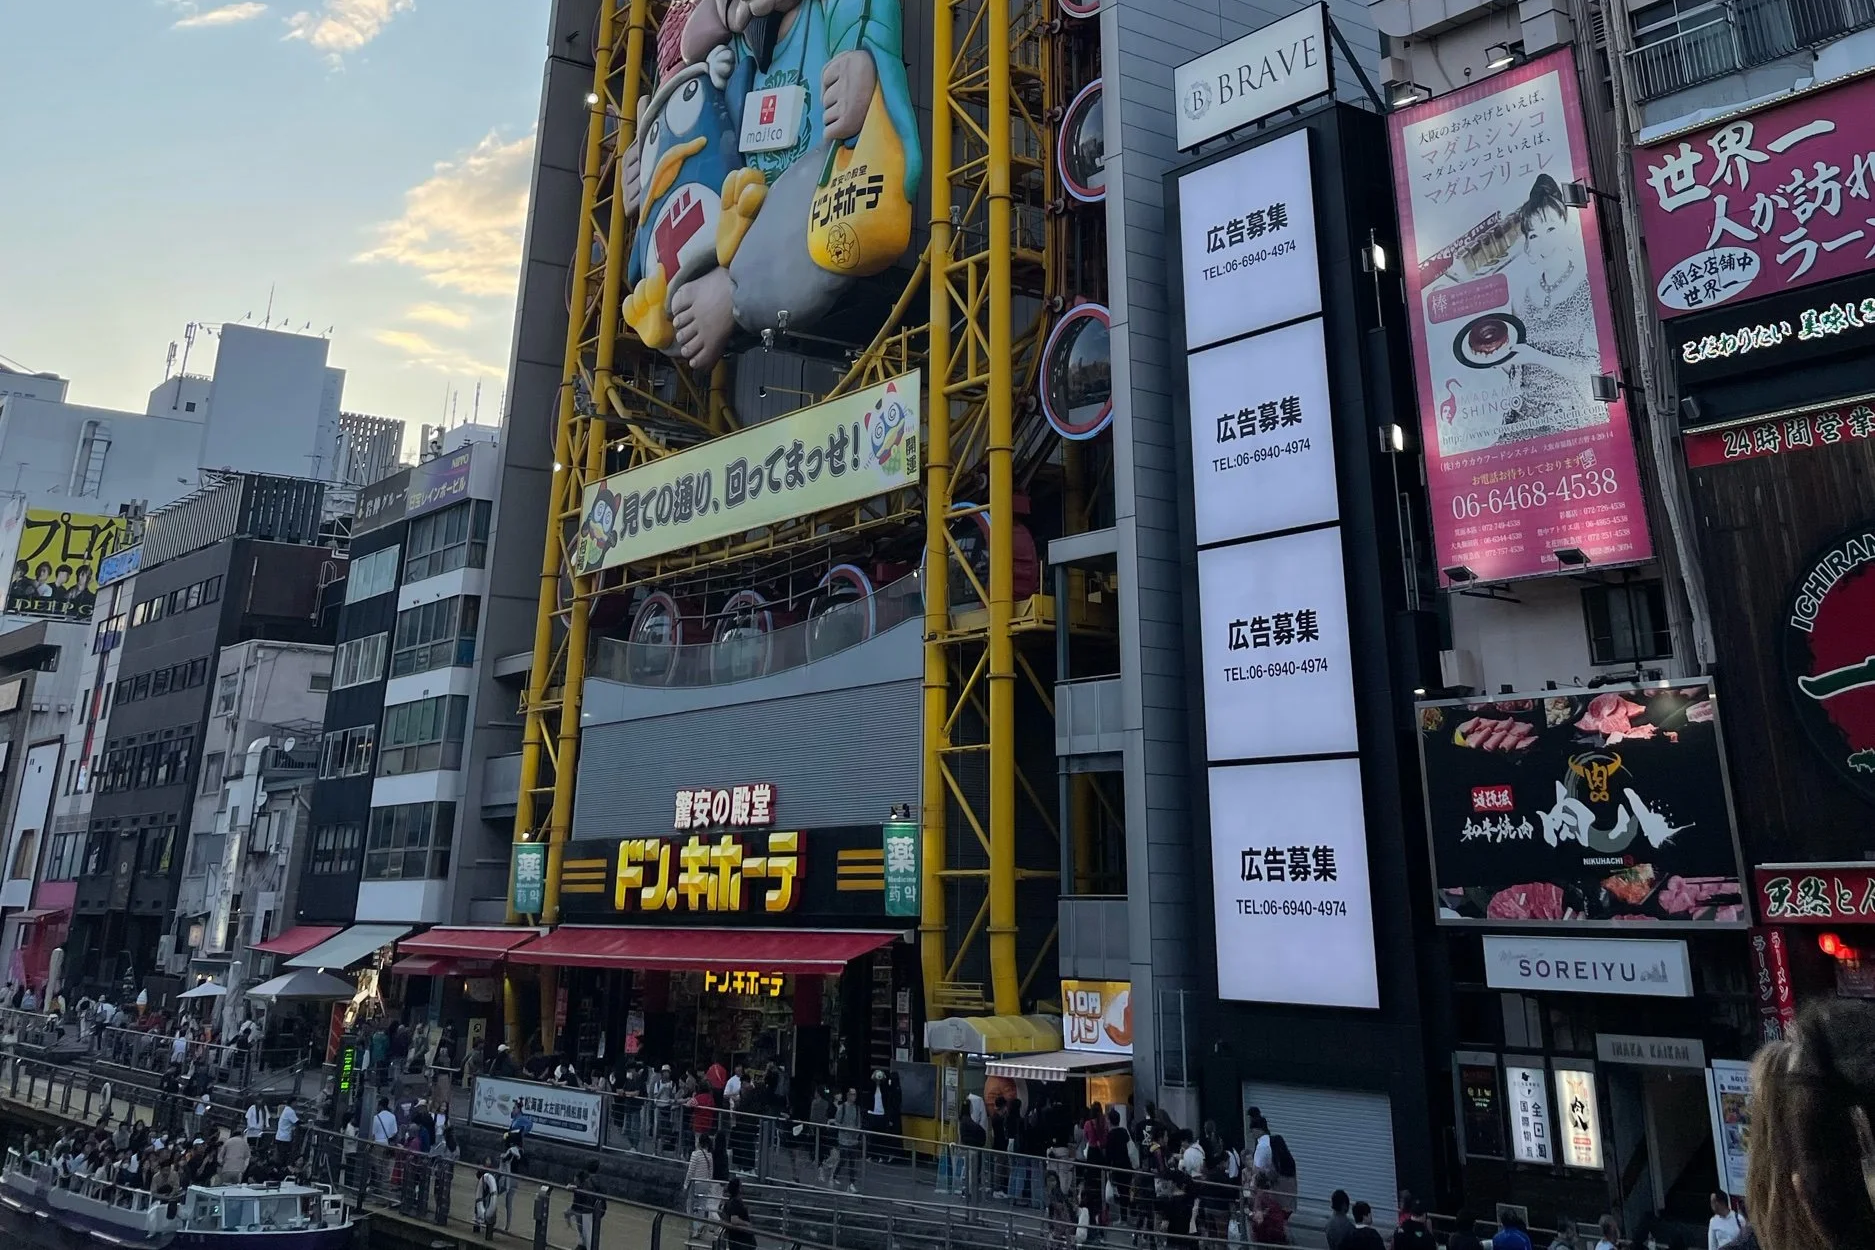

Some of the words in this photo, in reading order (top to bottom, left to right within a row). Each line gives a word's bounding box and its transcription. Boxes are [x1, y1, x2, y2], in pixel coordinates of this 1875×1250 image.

[1217, 34, 1318, 106] BRAVE
[1421, 110, 1545, 166] マダムシンコ
[1424, 152, 1555, 205] マダムブリュレ
[1646, 119, 1836, 213] 世界一
[1206, 203, 1289, 255] 広告募集
[1202, 239, 1297, 281] TEL:06-6940-4974
[1660, 253, 1754, 298] 一蘭全店舗中
[1683, 279, 1740, 308] 世界一
[1682, 321, 1792, 363] こだわりたい
[1216, 396, 1302, 444] 広告募集
[1722, 405, 1875, 458] 24時間営業
[1212, 438, 1312, 474] TEL:06-6940-4974
[1452, 467, 1618, 521] 06-6468-4538
[1228, 609, 1320, 652] 広告募集
[1224, 657, 1328, 683] TEL:06-6940-4974
[674, 783, 773, 829] 驚安の殿堂
[1460, 813, 1534, 843] 和牛焼肉
[517, 853, 541, 881] 薬
[886, 836, 916, 873] 薬
[1240, 846, 1338, 882] 広告募集
[1583, 857, 1623, 865] NIKUHACHI
[1236, 899, 1347, 917] TEL:06-6940-4974
[1519, 959, 1636, 982] SOREIYU
[1753, 935, 1774, 1001] ラーメン
[1771, 931, 1789, 1002] ラーメン
